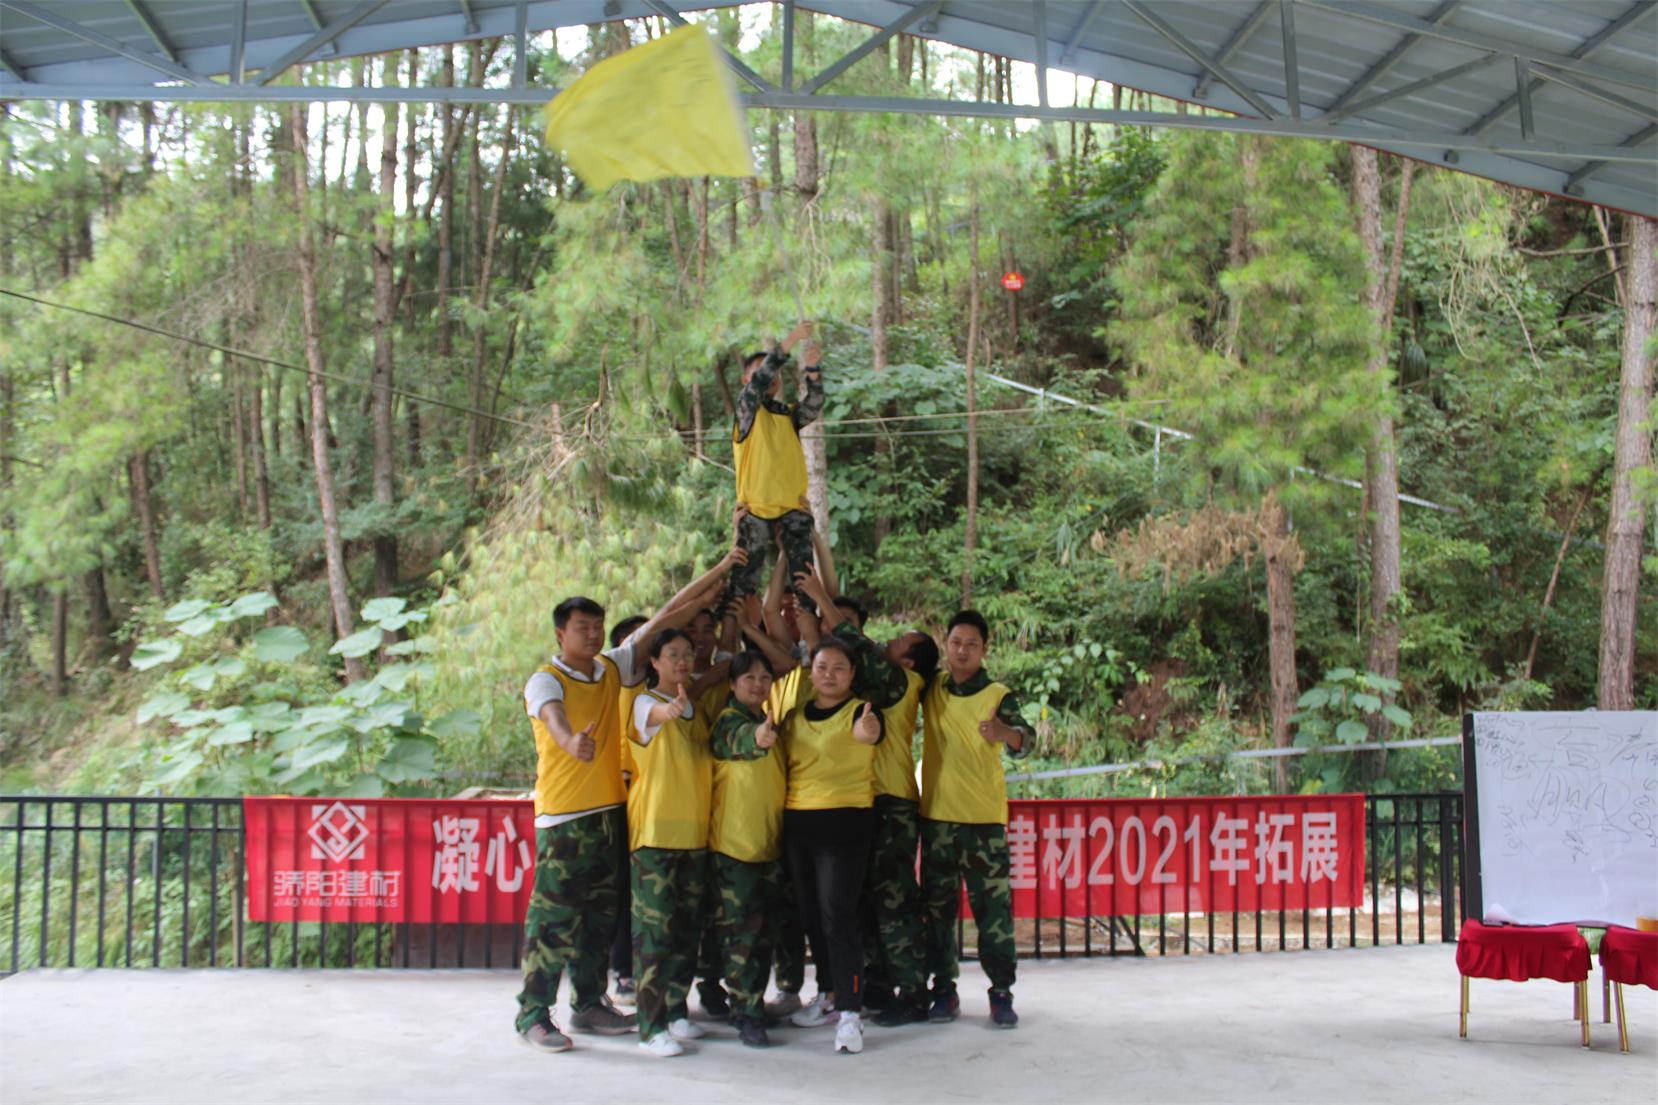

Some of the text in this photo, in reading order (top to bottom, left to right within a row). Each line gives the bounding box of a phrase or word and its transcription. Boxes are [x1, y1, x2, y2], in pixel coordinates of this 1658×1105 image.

[432, 811, 1338, 894] 凝心 建材2021年拓展
[273, 898, 399, 908] JIAO YANG MATERIALS
